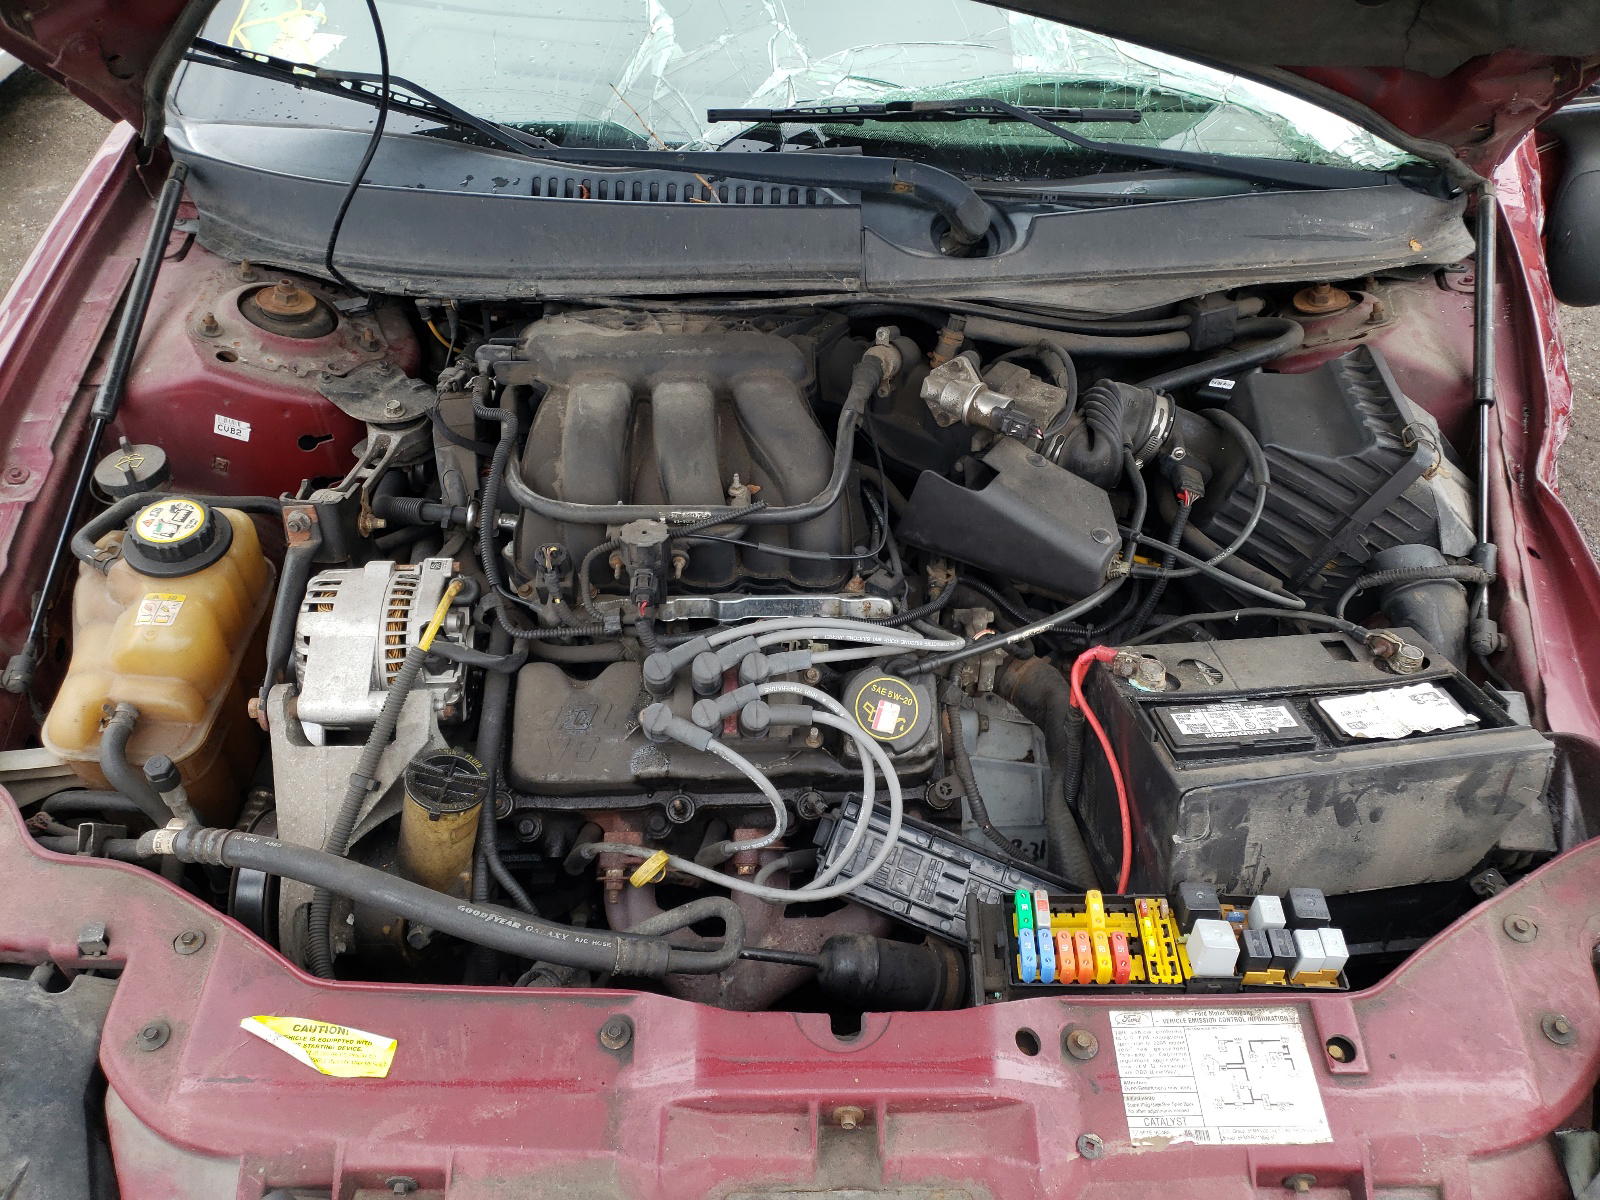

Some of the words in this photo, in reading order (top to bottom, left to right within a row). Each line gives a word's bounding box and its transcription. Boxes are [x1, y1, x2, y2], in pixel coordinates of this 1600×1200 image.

[217, 424, 242, 437] CVB2
[870, 684, 887, 696] SAE
[887, 690, 913, 706] 5W-20
[457, 904, 521, 929] GOODYEAR
[574, 936, 589, 944] A/C
[1143, 1116, 1187, 1127] CATALYST
